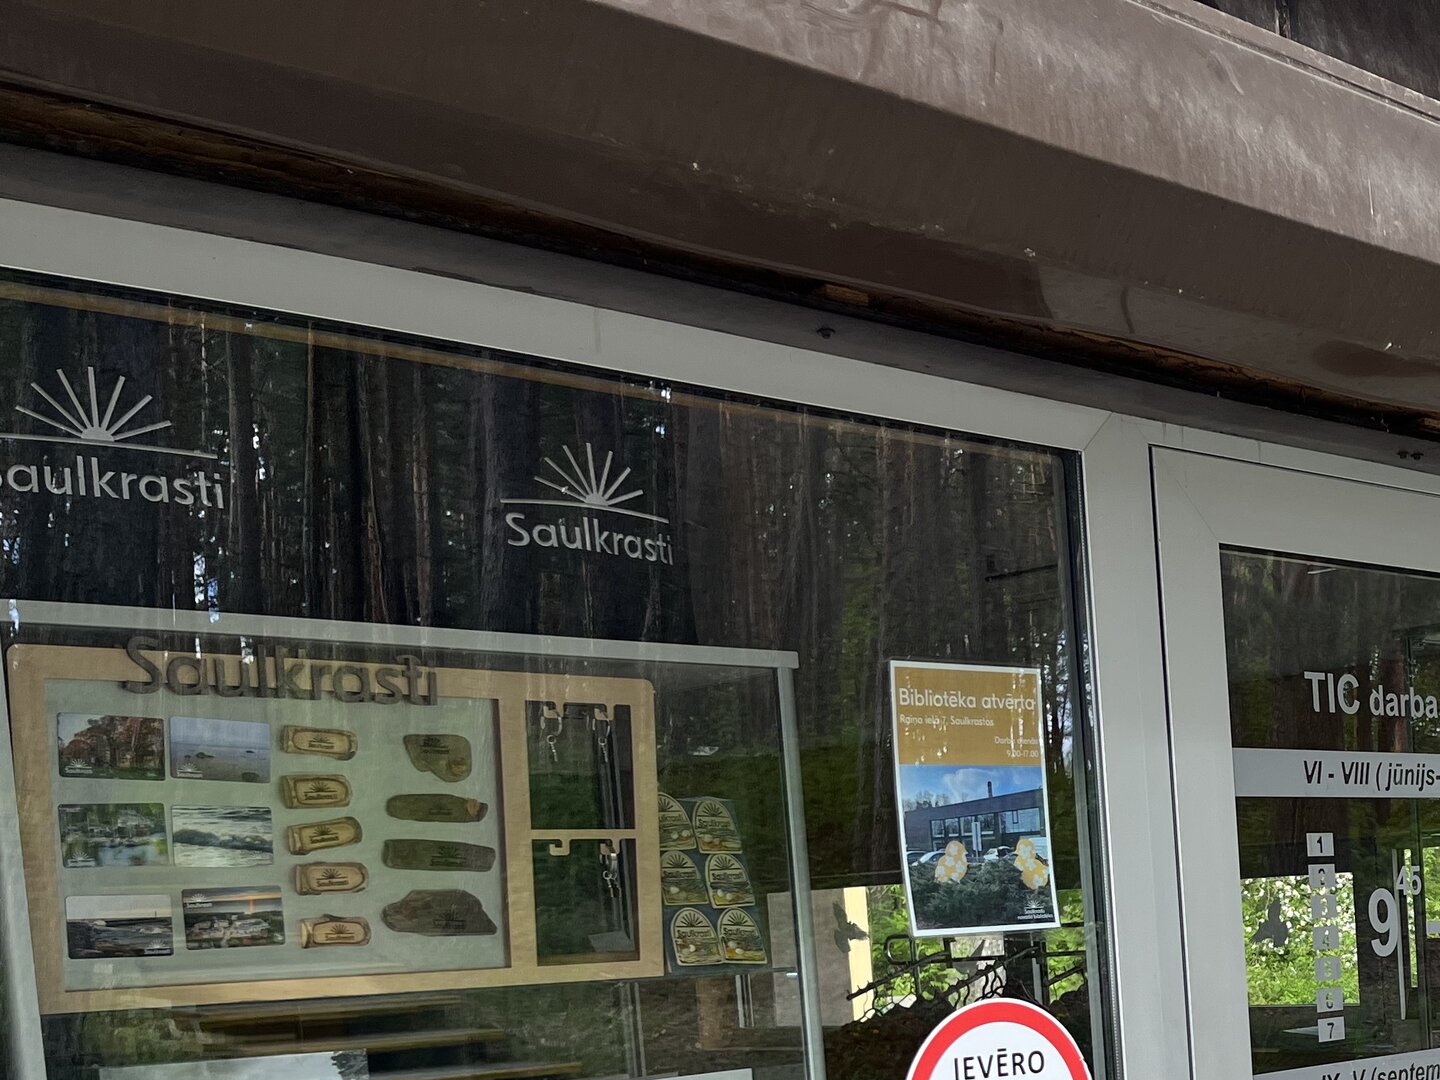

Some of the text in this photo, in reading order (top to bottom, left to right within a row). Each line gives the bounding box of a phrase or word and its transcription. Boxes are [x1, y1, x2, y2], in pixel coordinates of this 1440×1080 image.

[0, 455, 224, 509] aulkrasti
[505, 512, 673, 566] Saulkrasti
[118, 636, 437, 706] Saulkrasti
[1304, 671, 1360, 715] TIC
[1369, 685, 1438, 718] darba
[899, 688, 1036, 710] Bibliotēka atvērta
[1303, 760, 1322, 785] VI
[1341, 761, 1370, 785] VIII
[1368, 888, 1400, 957] 9
[1395, 865, 1421, 896] 45
[954, 1048, 1045, 1080] IEVĒRO
